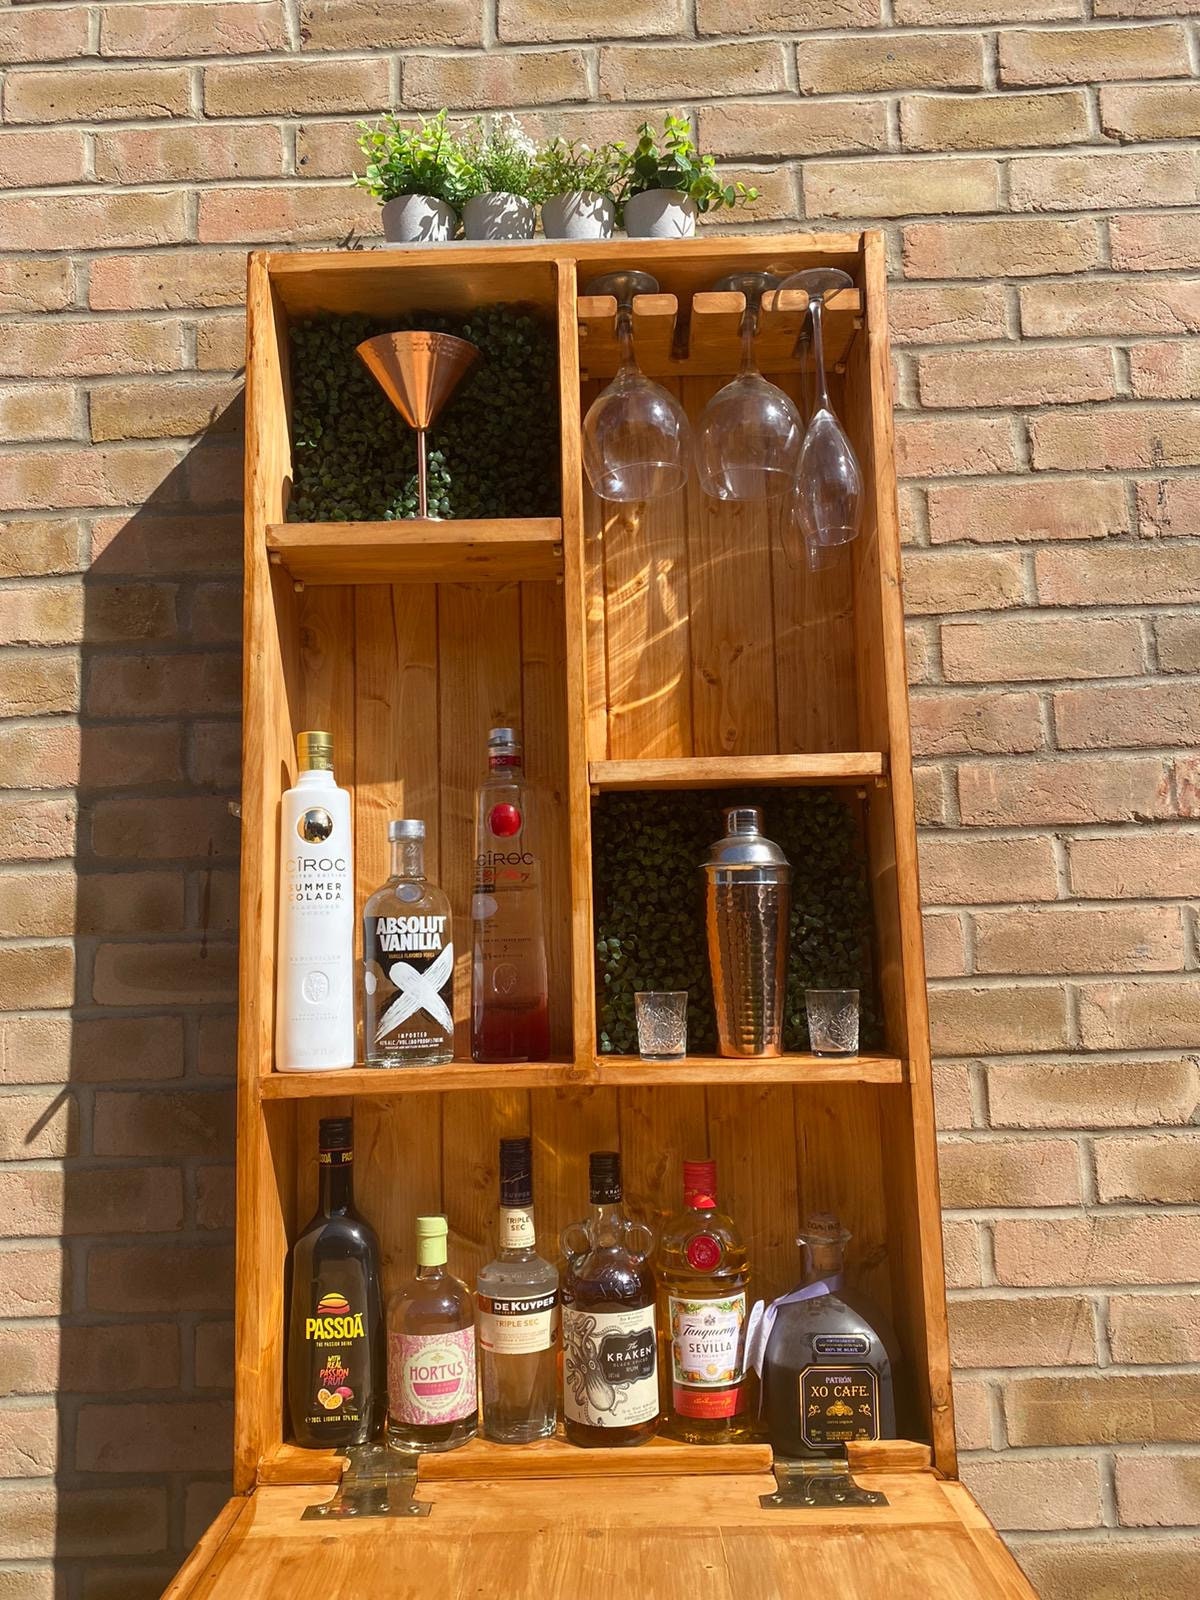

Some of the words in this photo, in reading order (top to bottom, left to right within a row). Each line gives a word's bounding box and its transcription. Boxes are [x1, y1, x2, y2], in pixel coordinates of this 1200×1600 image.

[286, 856, 346, 873] CÎROC
[477, 850, 534, 866] CÎROC
[376, 915, 447, 935] ABSOLUT
[380, 932, 443, 952] VANILIA
[397, 1031, 428, 1039] IMPORTED
[494, 1302, 510, 1311] DE
[511, 1296, 554, 1311] KUYPER
[305, 1312, 365, 1340] PASSOÃ
[495, 1320, 522, 1328] TRIPLE
[523, 1319, 540, 1327] SEC
[683, 1324, 737, 1339] Tanqueray
[607, 1345, 651, 1362] KRAKEN
[689, 1343, 732, 1353] SEVILLA
[319, 1367, 350, 1378] PASSION
[410, 1361, 464, 1381] HORTUS
[323, 1376, 346, 1387] FRUIT
[825, 1376, 852, 1384] PATRÓN
[811, 1386, 829, 1398] XO
[834, 1386, 866, 1397] CAFE
